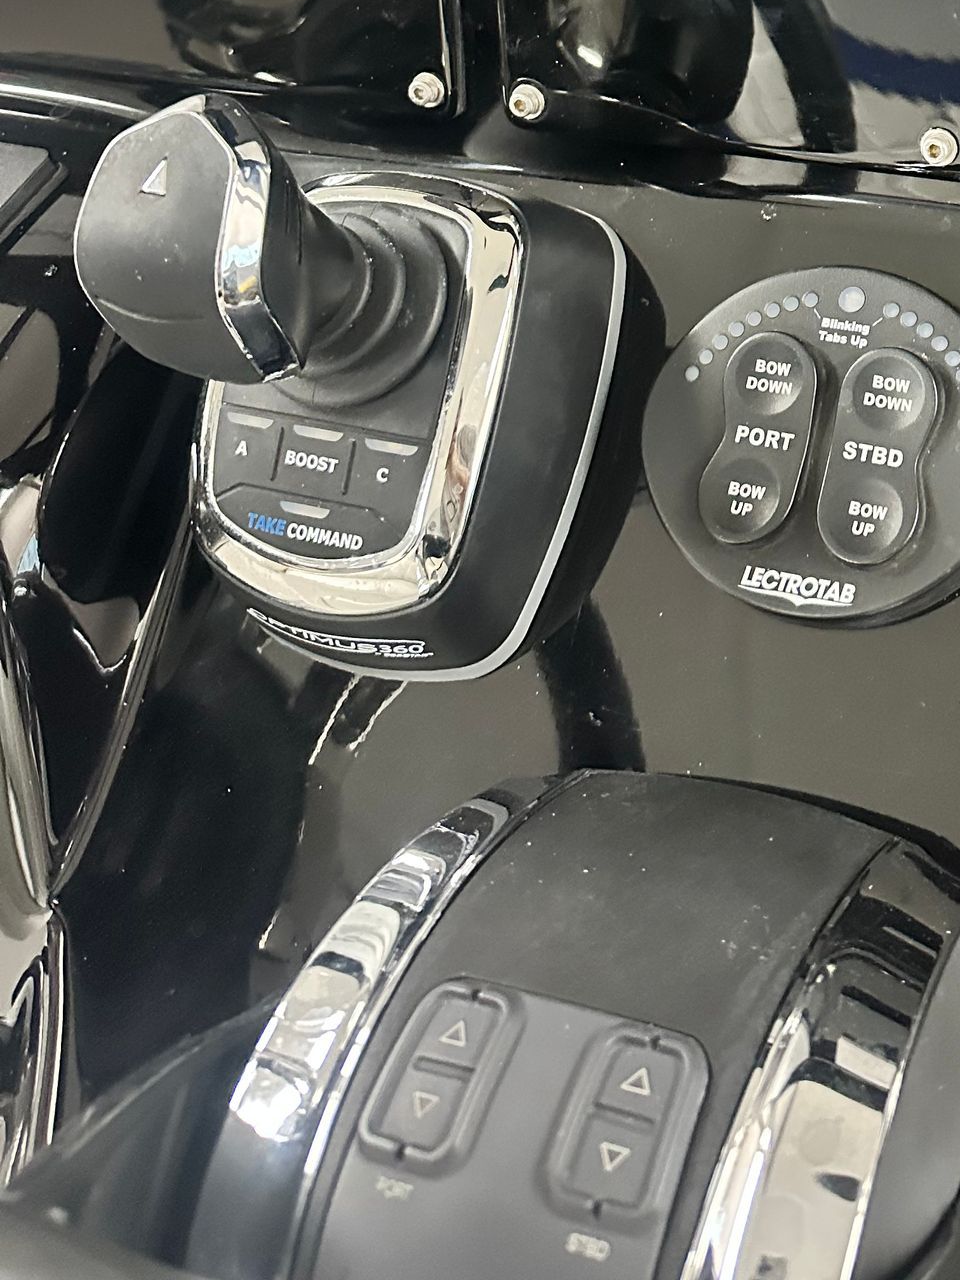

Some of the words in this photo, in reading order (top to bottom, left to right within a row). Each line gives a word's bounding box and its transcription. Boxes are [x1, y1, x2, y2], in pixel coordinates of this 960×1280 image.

[820, 317, 871, 336] Blinking
[818, 329, 848, 345] Tabs
[850, 334, 869, 349] Up
[754, 358, 792, 377] BOW
[745, 375, 793, 396] DOWN
[871, 374, 911, 394] BOW
[862, 391, 913, 413] DOWN
[235, 440, 248, 456] A
[734, 424, 796, 451] PORT
[284, 449, 339, 474] BOOST
[842, 440, 904, 469] STBD
[376, 466, 390, 484] C
[727, 480, 767, 501] BOW
[730, 499, 754, 517] UP
[848, 500, 889, 521] BOW
[248, 512, 285, 536] TAKE
[286, 522, 363, 551] COMMAND
[851, 520, 876, 538] UP
[740, 565, 856, 603] LECTROTAB
